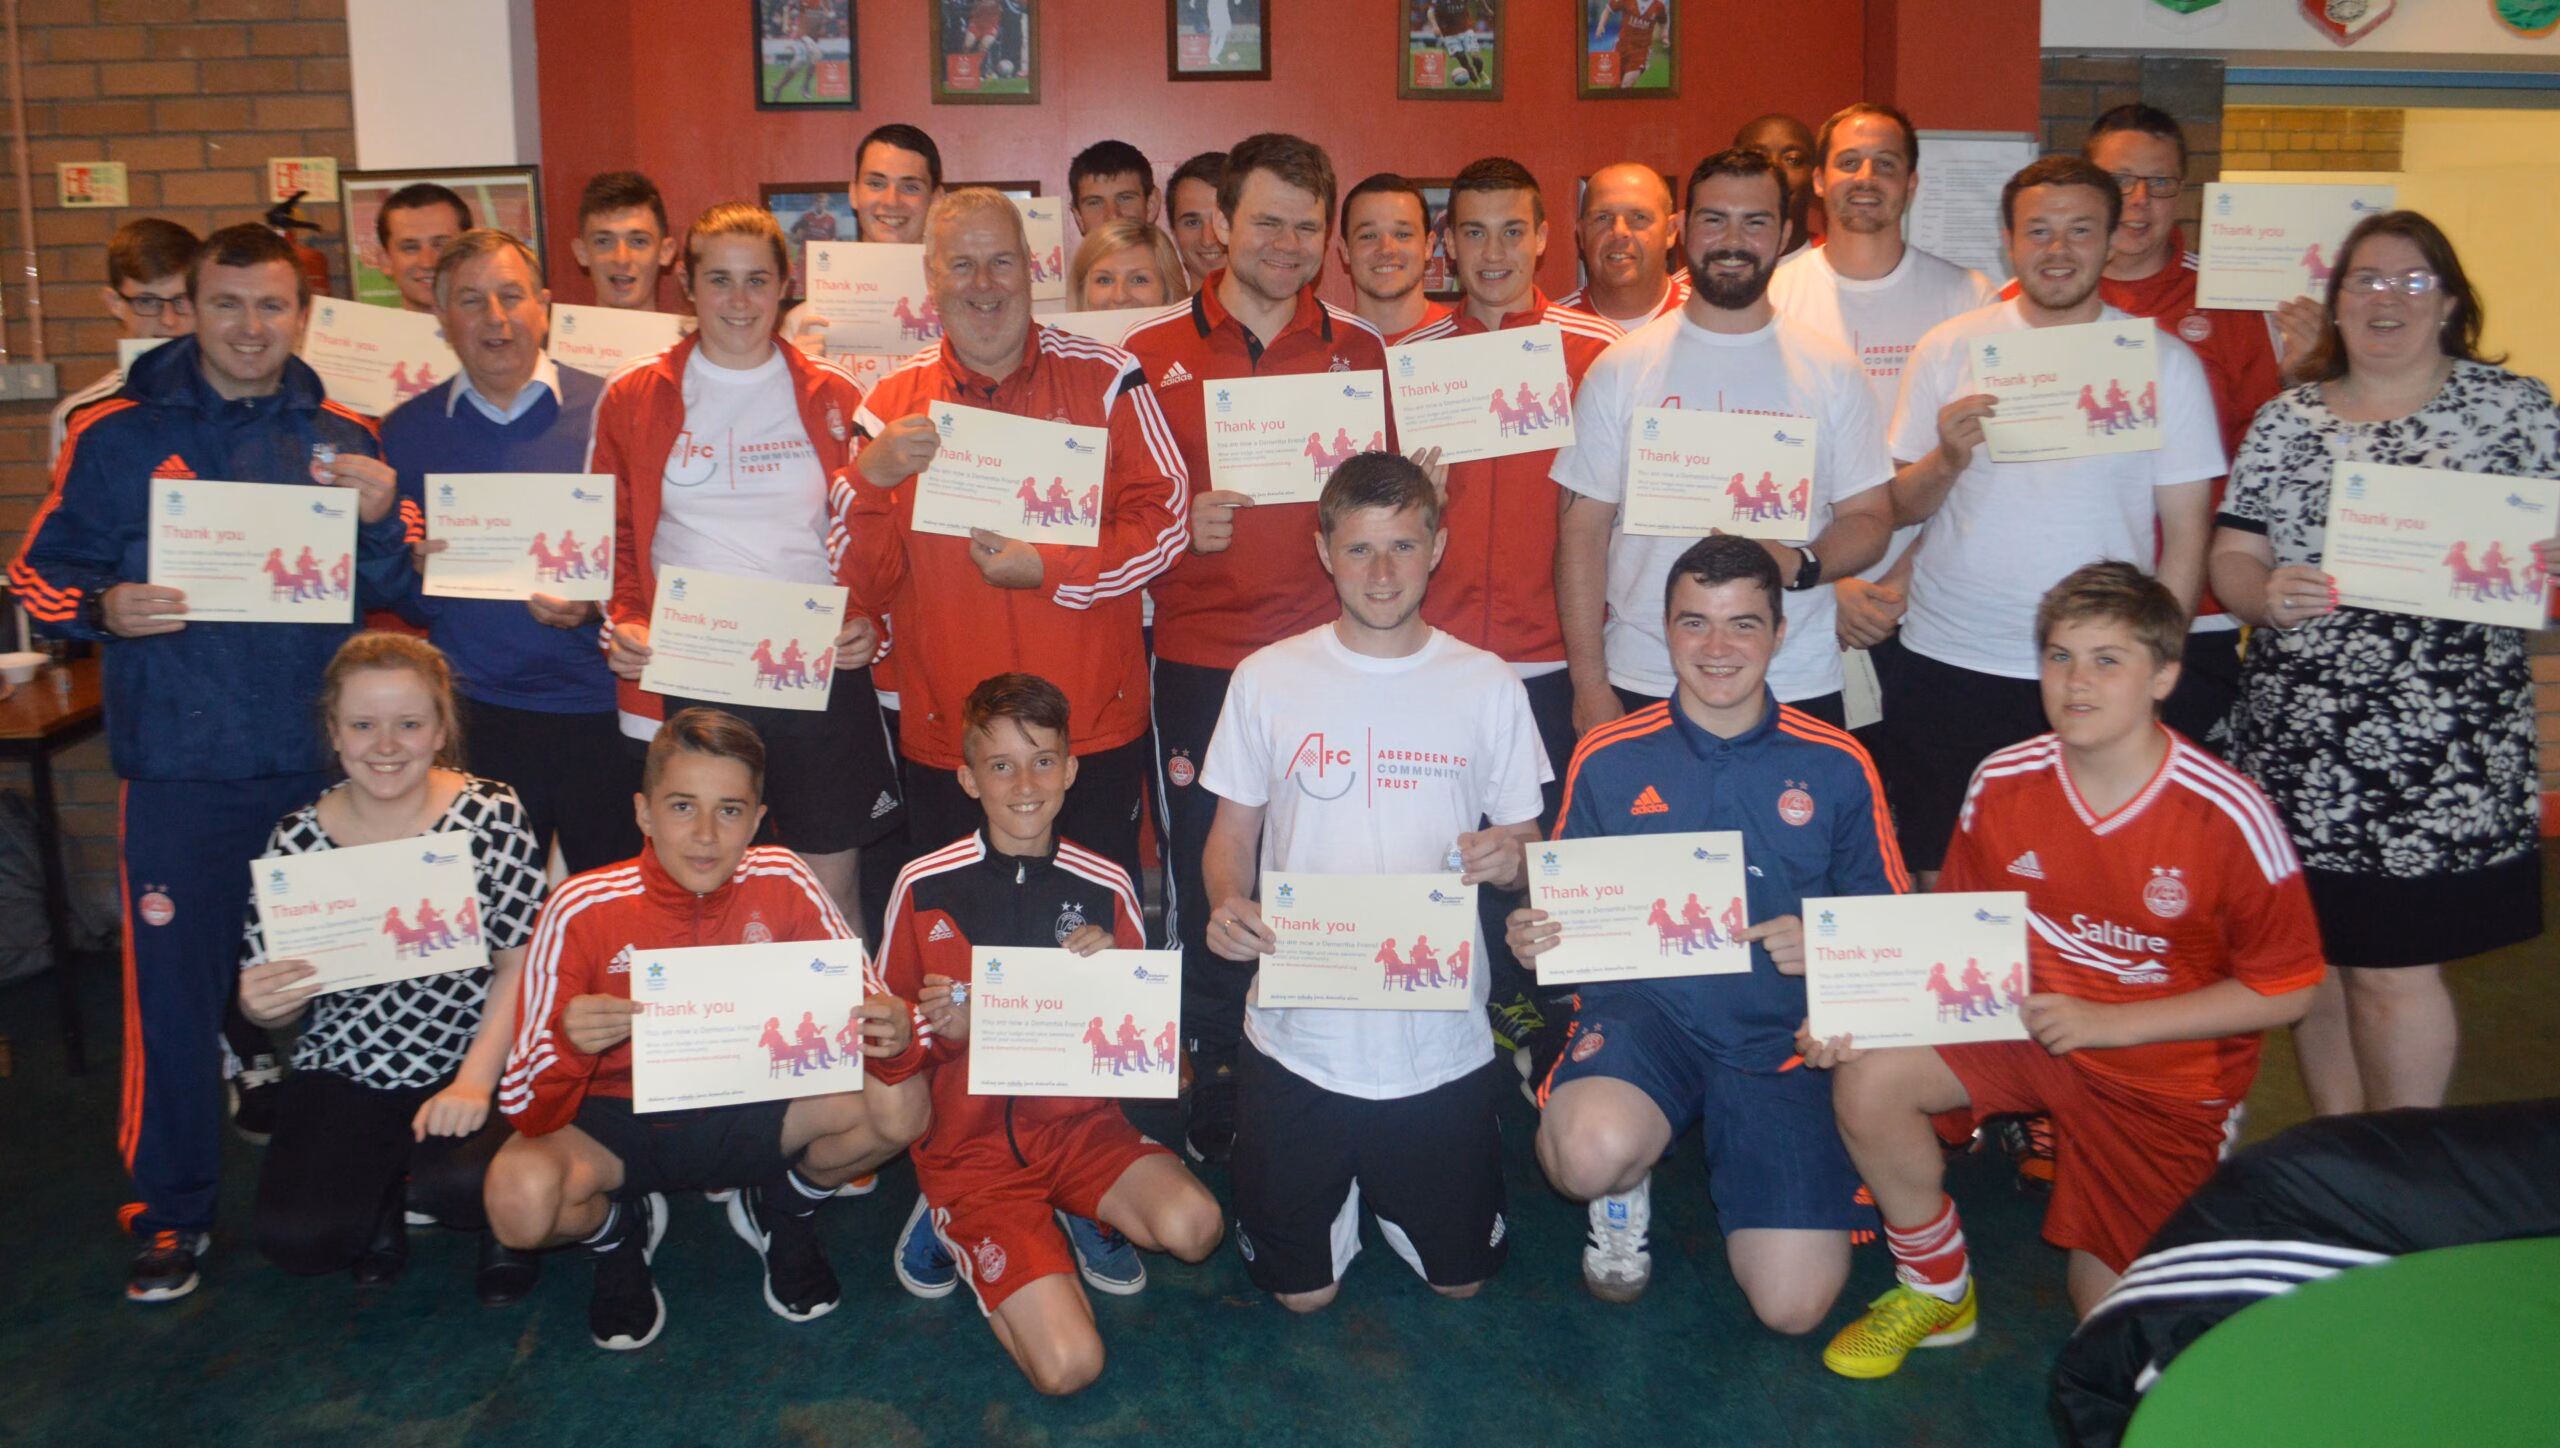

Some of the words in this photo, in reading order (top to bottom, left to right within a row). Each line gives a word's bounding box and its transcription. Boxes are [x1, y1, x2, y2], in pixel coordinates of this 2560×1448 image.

[815, 279, 850, 290] Thank
[855, 282, 879, 294] you
[1160, 373, 1192, 388] adidas
[1400, 382, 1440, 398] Thank
[1444, 379, 1468, 394] you
[1983, 373, 2026, 388] Thank
[2032, 373, 2058, 388] you
[1214, 420, 1256, 433] Thank
[1261, 419, 1286, 434] you
[739, 440, 801, 453] ABERDEEN
[940, 446, 972, 462] hank
[976, 454, 1002, 468] you
[1638, 448, 1680, 463] Thank
[1684, 454, 1711, 468] you
[740, 464, 782, 473] TRUST
[436, 515, 480, 528] Thank
[485, 517, 512, 530] you
[2340, 508, 2388, 526] Thank
[2394, 516, 2427, 532] you
[161, 525, 212, 540] Thank
[215, 528, 246, 544] you
[663, 607, 706, 626] Thank
[711, 618, 738, 631] you
[1378, 750, 1449, 764] ABERDEEN
[1453, 756, 1468, 768] FC
[1377, 764, 1462, 780] COMMUNITY
[1377, 778, 1419, 790] TRUST
[1540, 884, 1590, 900] Thank
[1594, 884, 1624, 900] you
[270, 900, 320, 920] Thank
[326, 898, 357, 915] you
[1272, 916, 1320, 932] Thank
[1326, 920, 1356, 935] you
[2071, 913, 2168, 954] Saltire
[1816, 946, 1866, 961] Thank
[1872, 946, 1902, 963] you
[644, 1000, 697, 1018] Thank
[704, 1000, 736, 1019] you
[981, 994, 1029, 1010] Thank
[1034, 998, 1064, 1013] you
